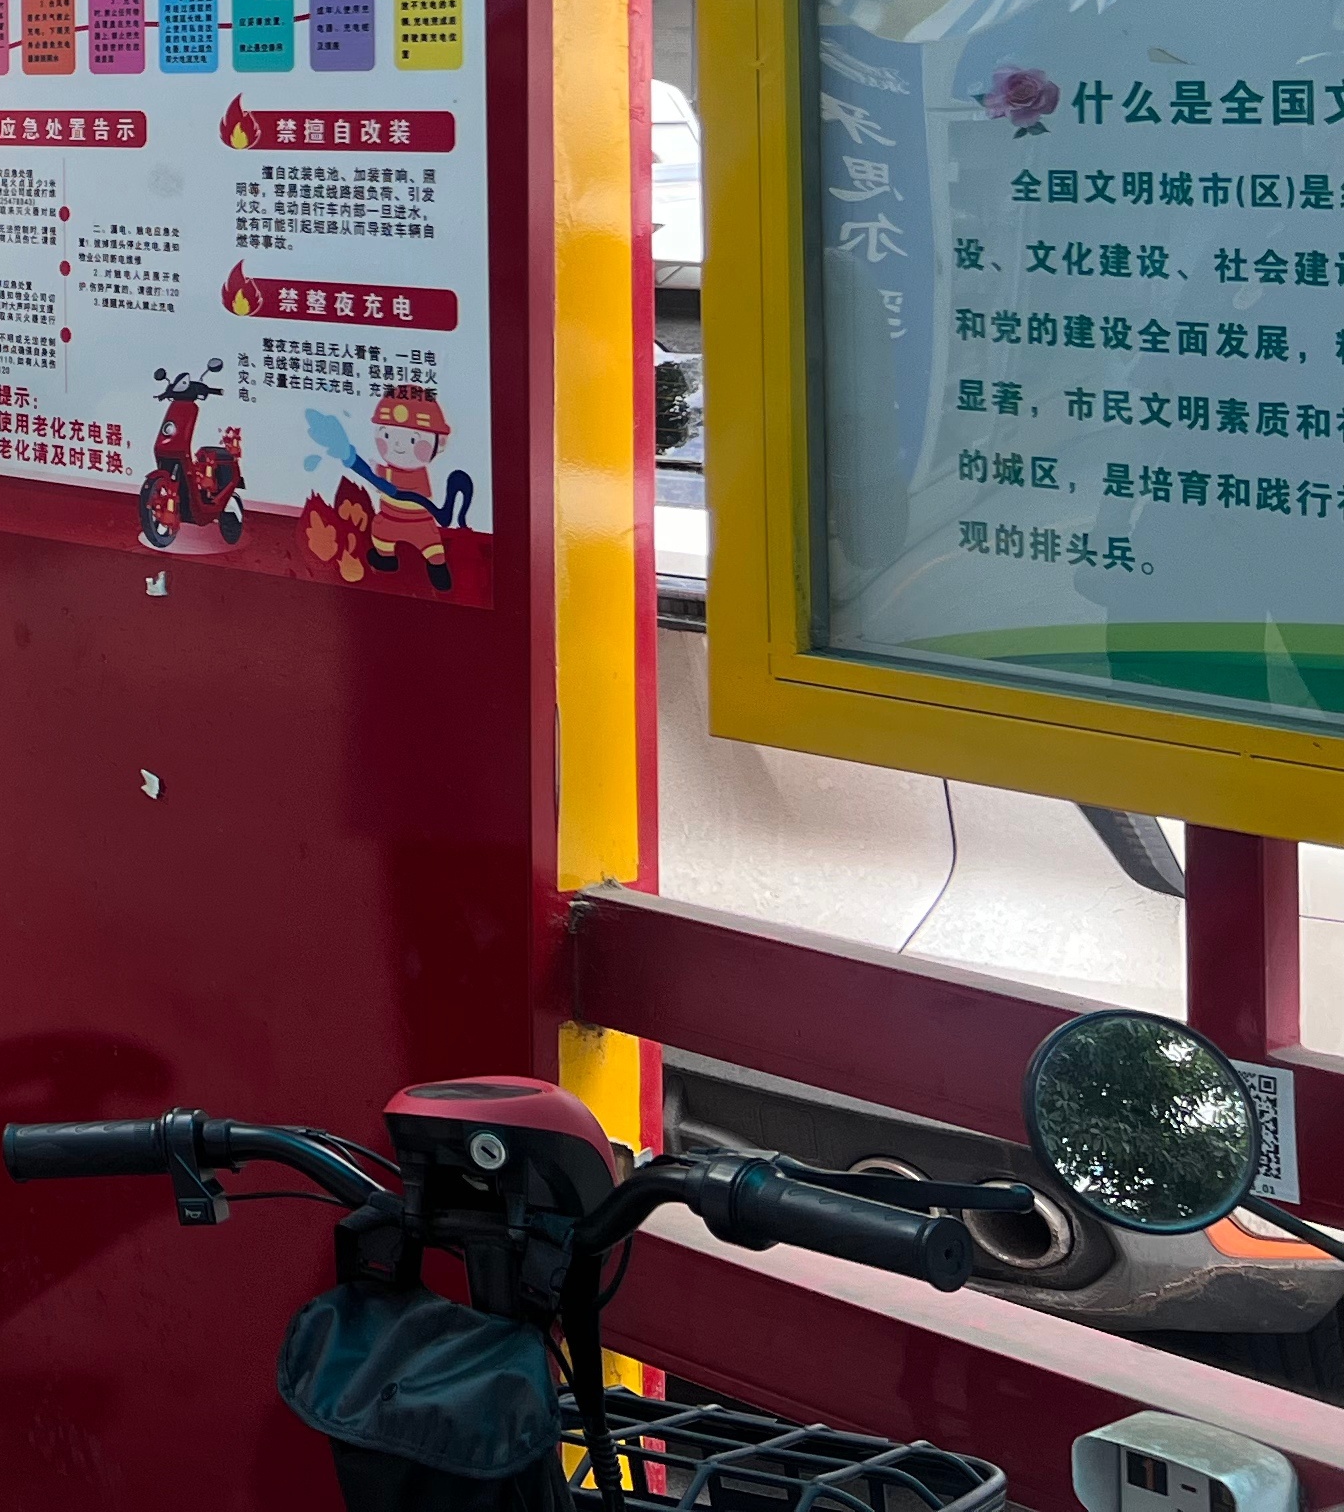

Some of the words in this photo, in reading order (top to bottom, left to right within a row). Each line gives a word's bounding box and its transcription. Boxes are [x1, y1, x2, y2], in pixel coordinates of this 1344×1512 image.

[0, 117, 136, 142] 应急处置告示
[276, 118, 412, 145] 禁擅自改装
[1011, 169, 1344, 211] 全国文明城市(区)是
[954, 238, 1344, 288] 设、文化建设、社会建
[279, 287, 414, 321] 禁整夜充电
[955, 309, 1344, 366] 和党的建设全面发展，
[238, 388, 256, 403] 电。
[956, 379, 1344, 443] 显著，市民文明素质和
[958, 450, 1344, 520] 的城区，是培育和践行
[958, 521, 1155, 577] 观的排头兵。
